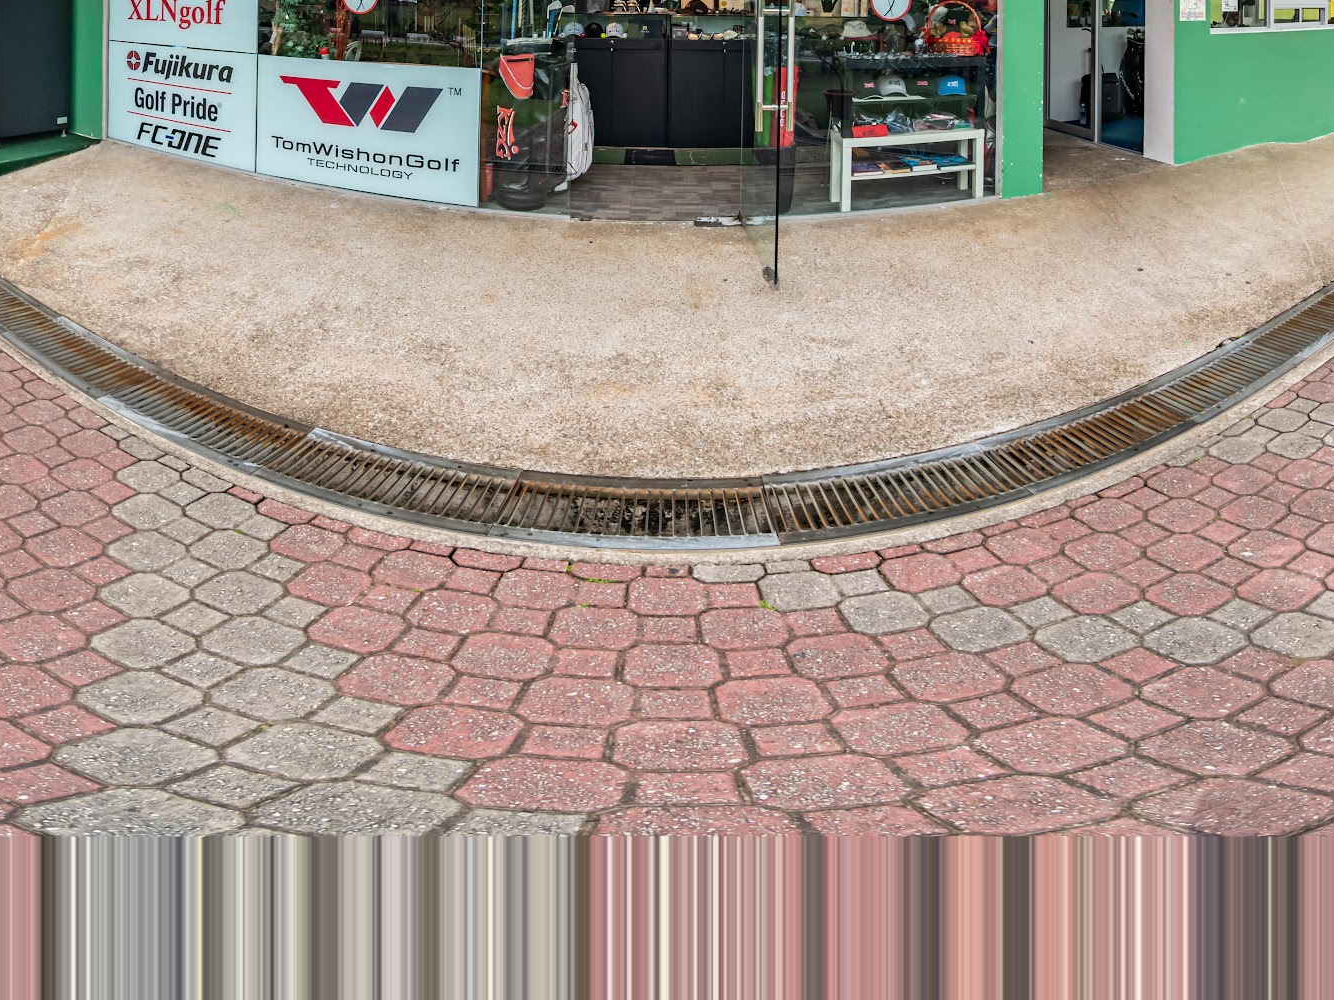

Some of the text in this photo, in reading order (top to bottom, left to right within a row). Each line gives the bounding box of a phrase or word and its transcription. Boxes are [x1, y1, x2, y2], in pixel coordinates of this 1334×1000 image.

[142, 51, 234, 83] Fujikura
[134, 87, 166, 112] Golf
[307, 157, 413, 180] TECHNOLOGY
